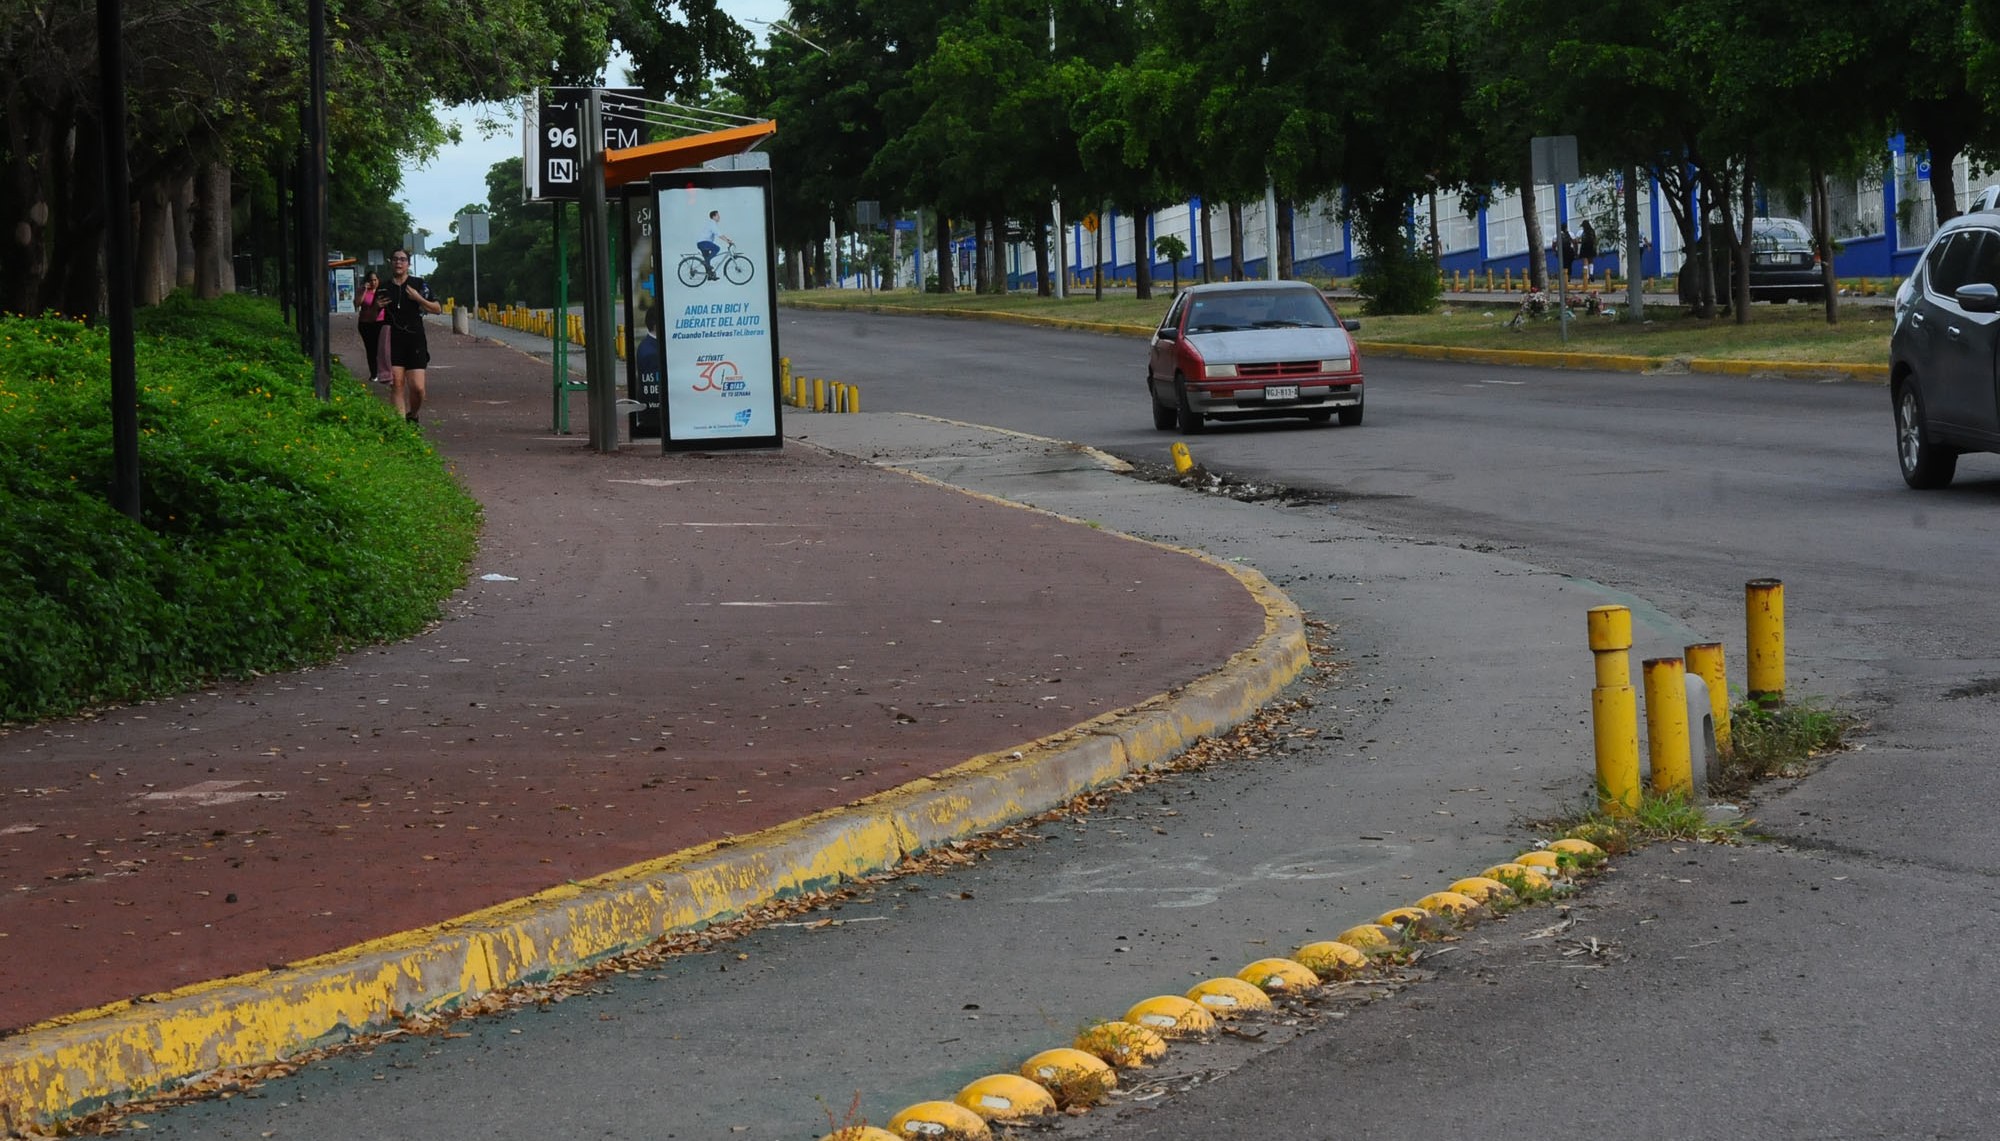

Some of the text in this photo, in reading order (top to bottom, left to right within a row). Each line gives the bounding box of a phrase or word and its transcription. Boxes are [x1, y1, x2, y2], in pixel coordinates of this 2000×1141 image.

[604, 128, 638, 148] FM
[685, 303, 749, 316] ANDA EN BICI Y
[718, 317, 733, 327] DEL
[736, 316, 760, 326] AUTO
[641, 373, 655, 383] LAS
[692, 361, 738, 391] 30
